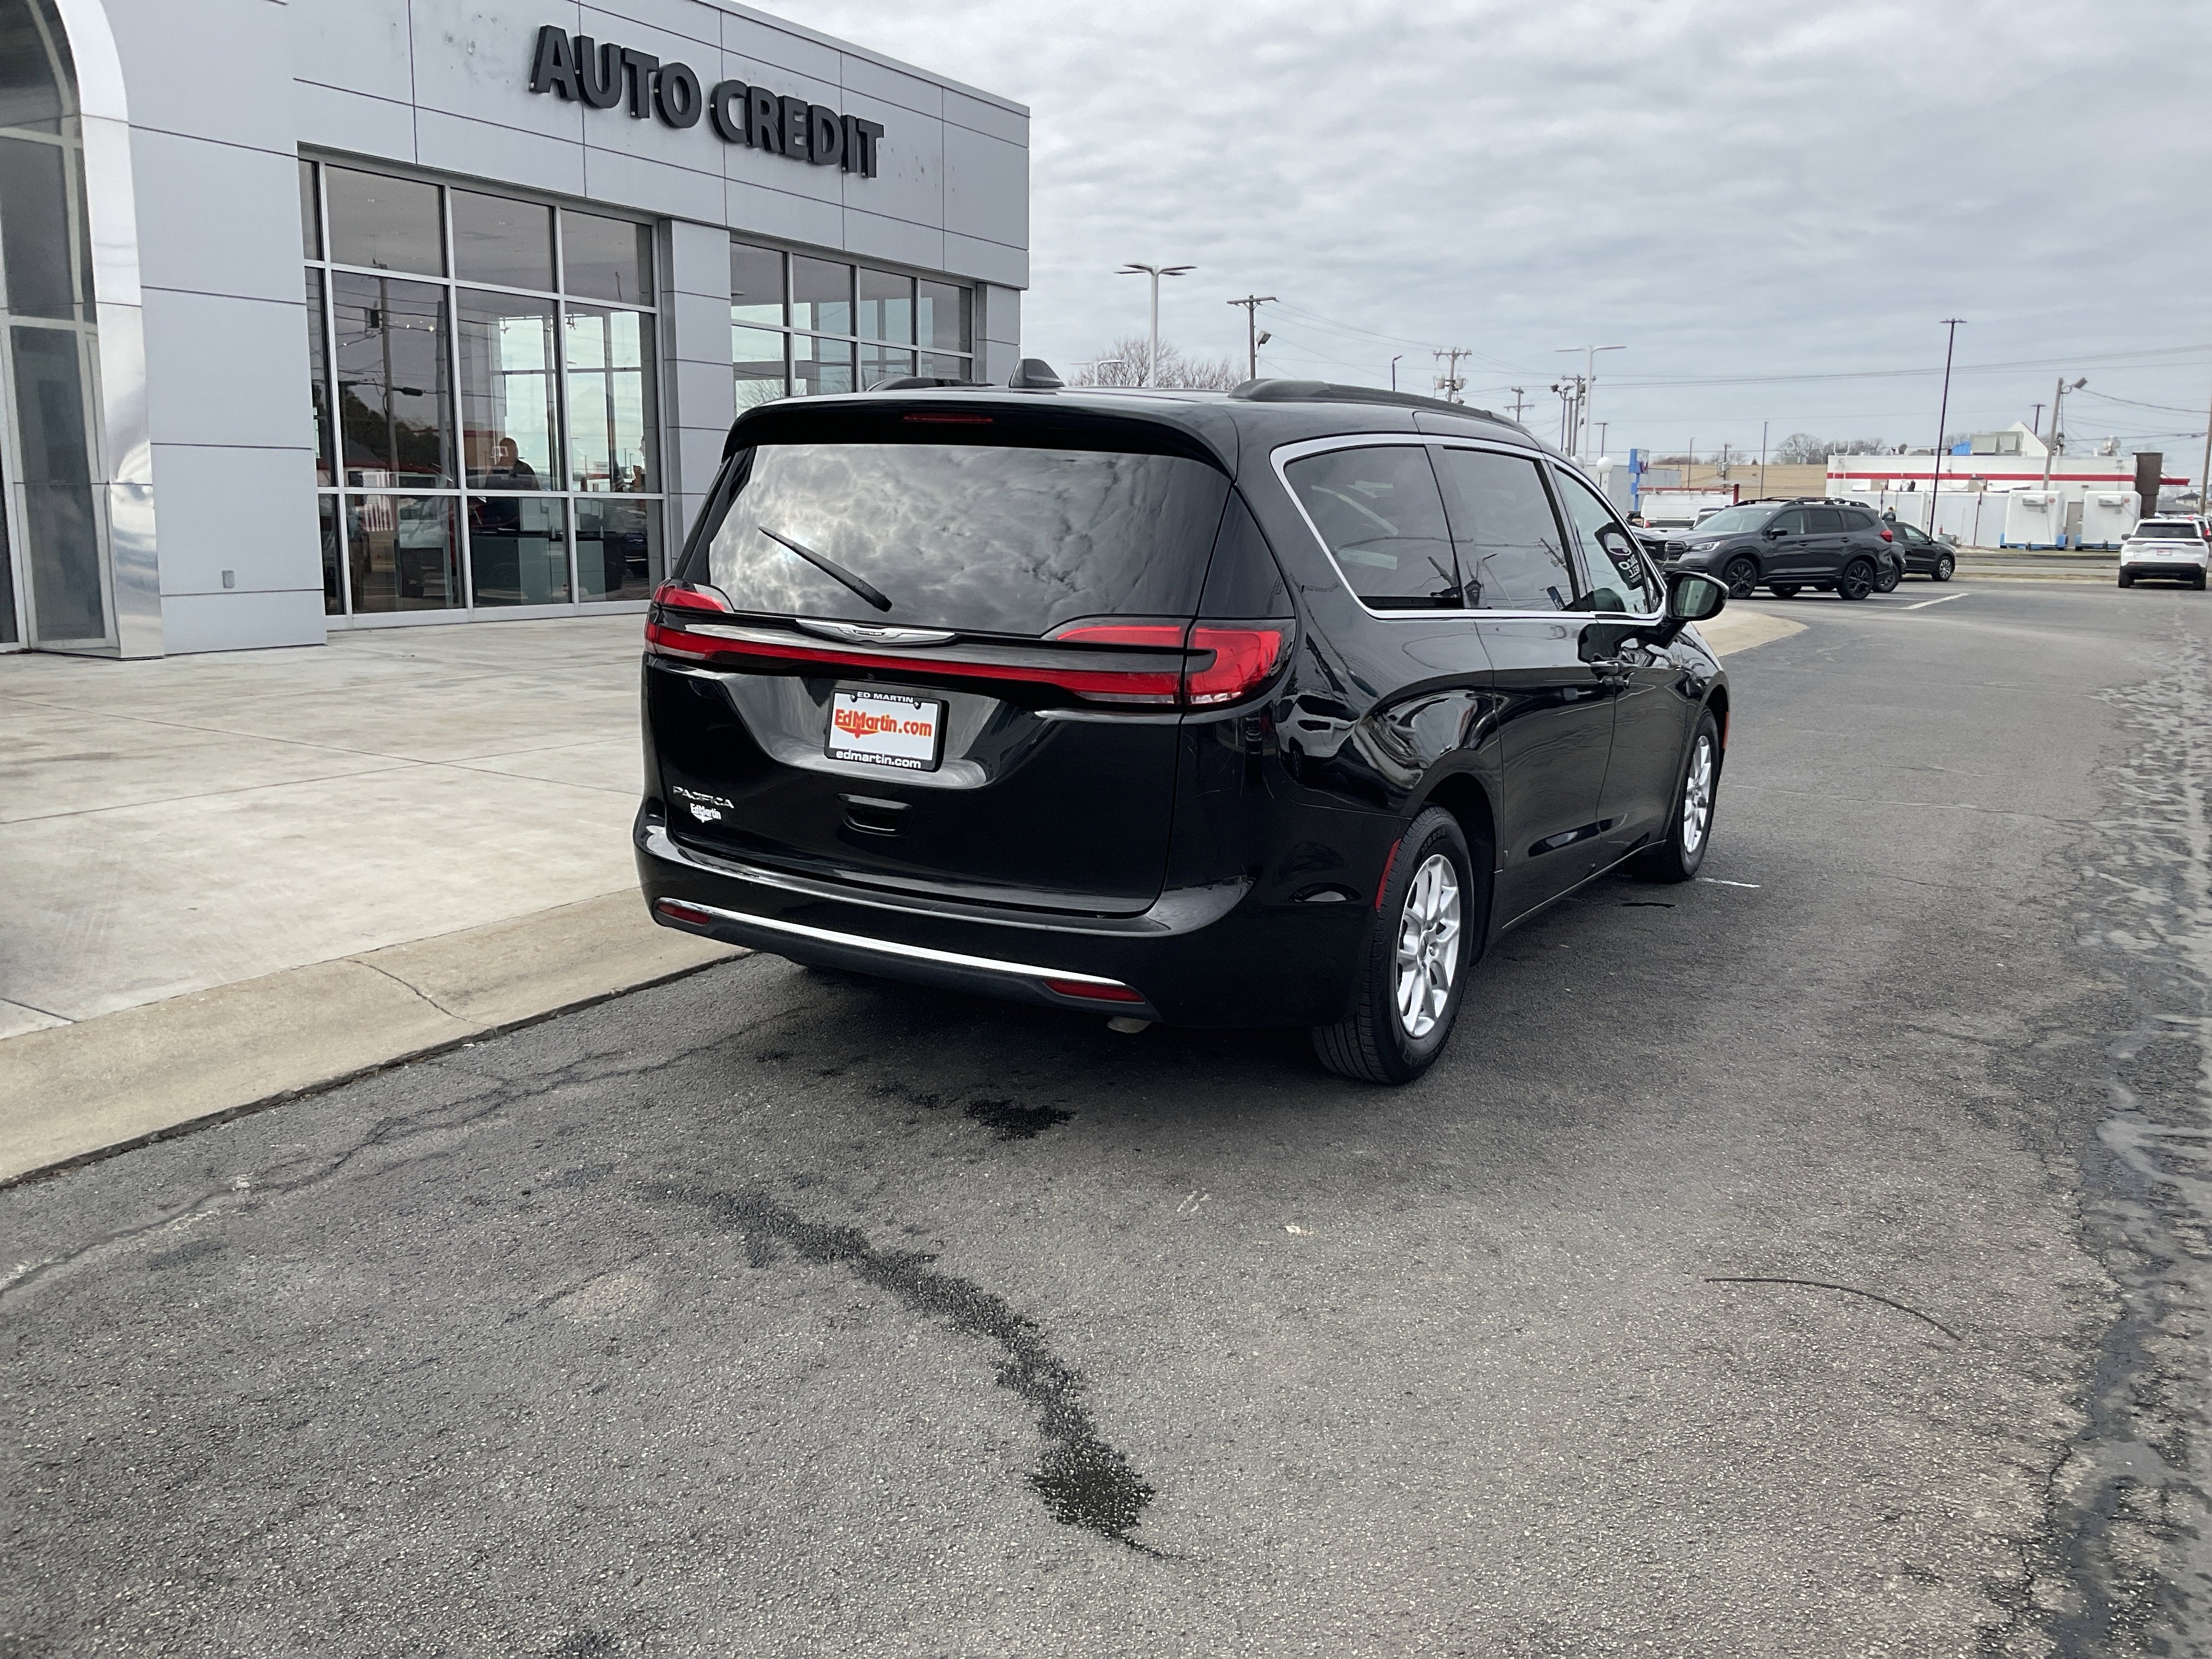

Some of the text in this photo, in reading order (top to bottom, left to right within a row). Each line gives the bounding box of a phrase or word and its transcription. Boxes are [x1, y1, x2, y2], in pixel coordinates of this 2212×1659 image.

[528, 25, 884, 178] AUTO CREDIT
[873, 693, 914, 703] MARTIN
[836, 749, 921, 769] edmartin.com
[673, 786, 734, 809] PACIFICA
[690, 803, 721, 820] EdMartin
